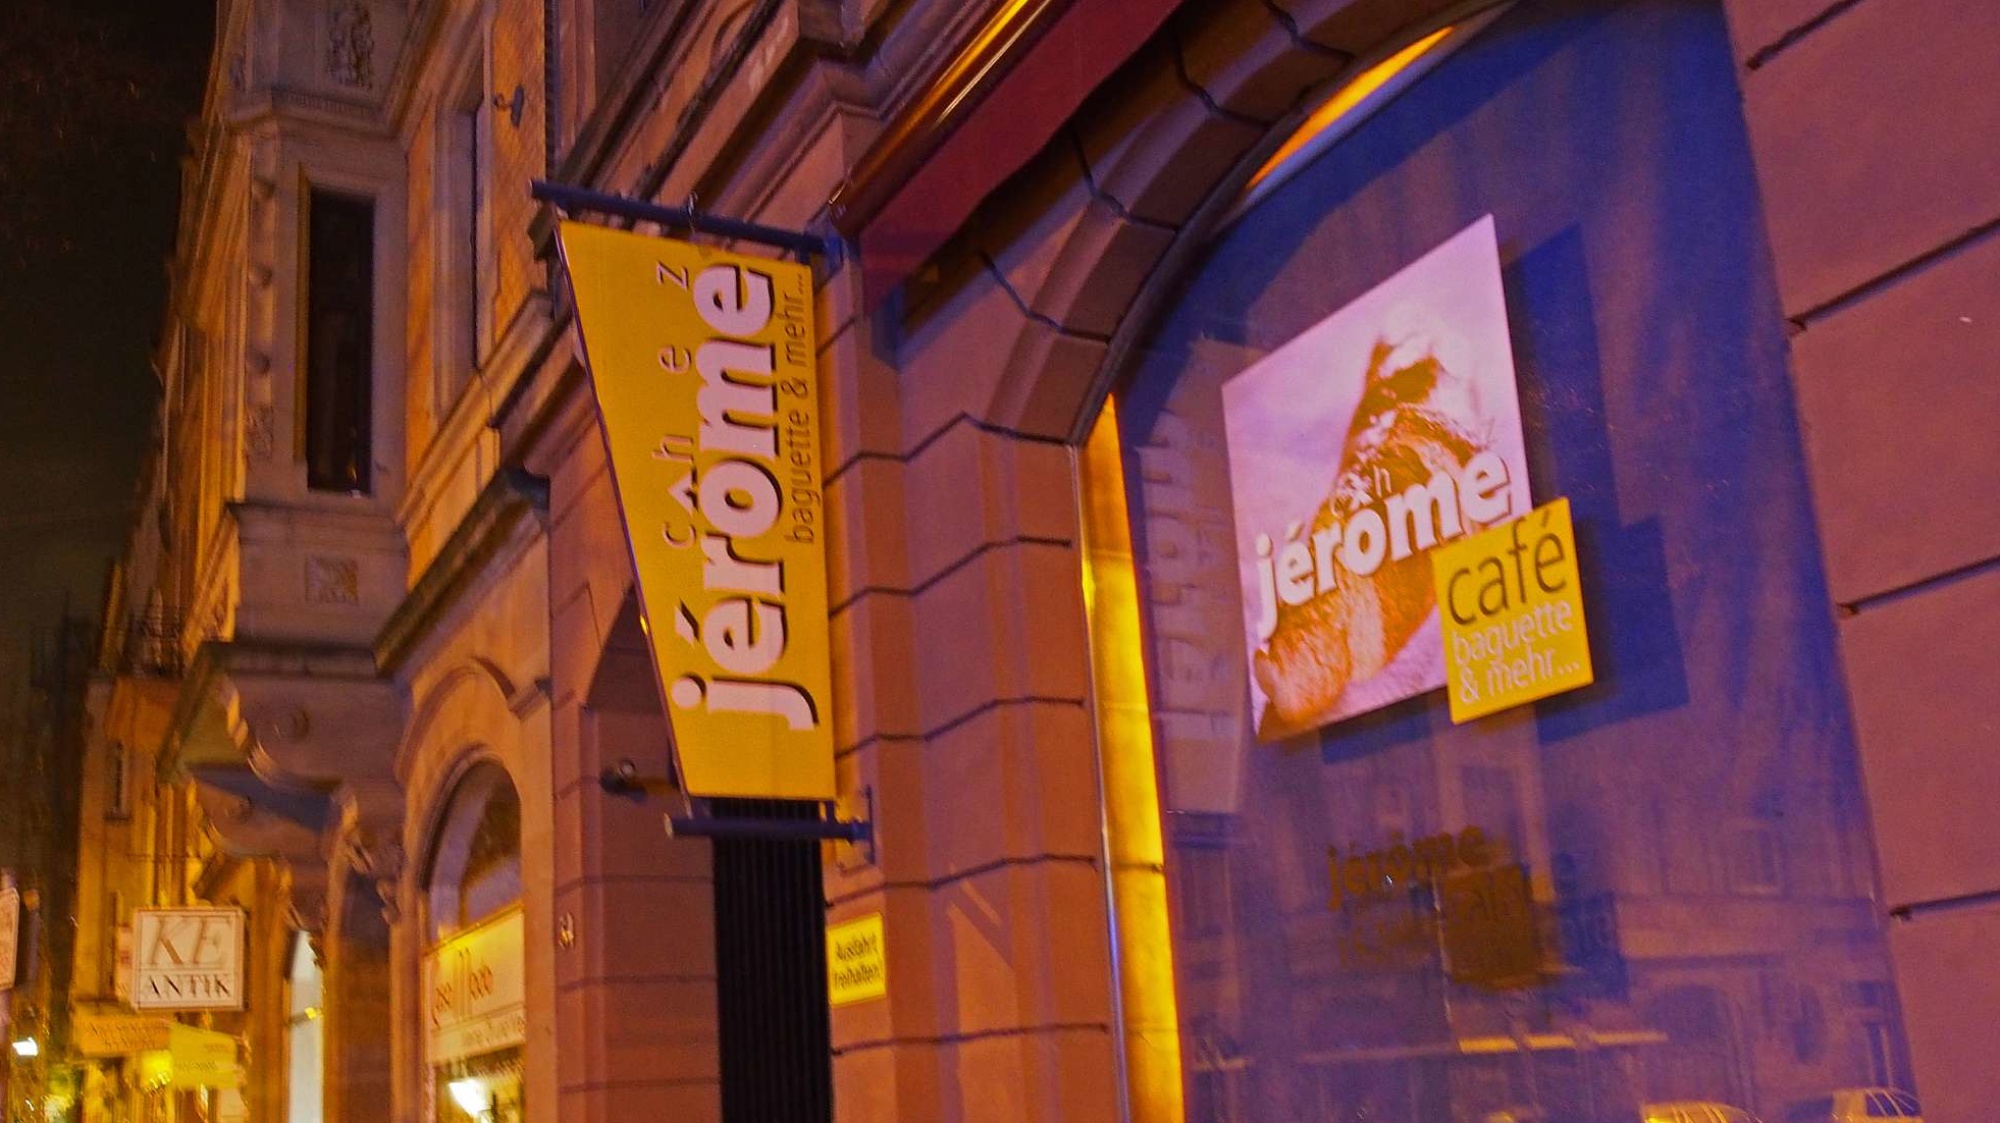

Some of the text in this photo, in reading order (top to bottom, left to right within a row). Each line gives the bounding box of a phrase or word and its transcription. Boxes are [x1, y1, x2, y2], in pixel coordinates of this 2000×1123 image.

[781, 376, 809, 399] &
[784, 408, 820, 545] baguette
[1446, 507, 1567, 626] café
[1452, 599, 1573, 667] baguette
[1458, 665, 1481, 705] &
[141, 973, 231, 999] ANTIK
